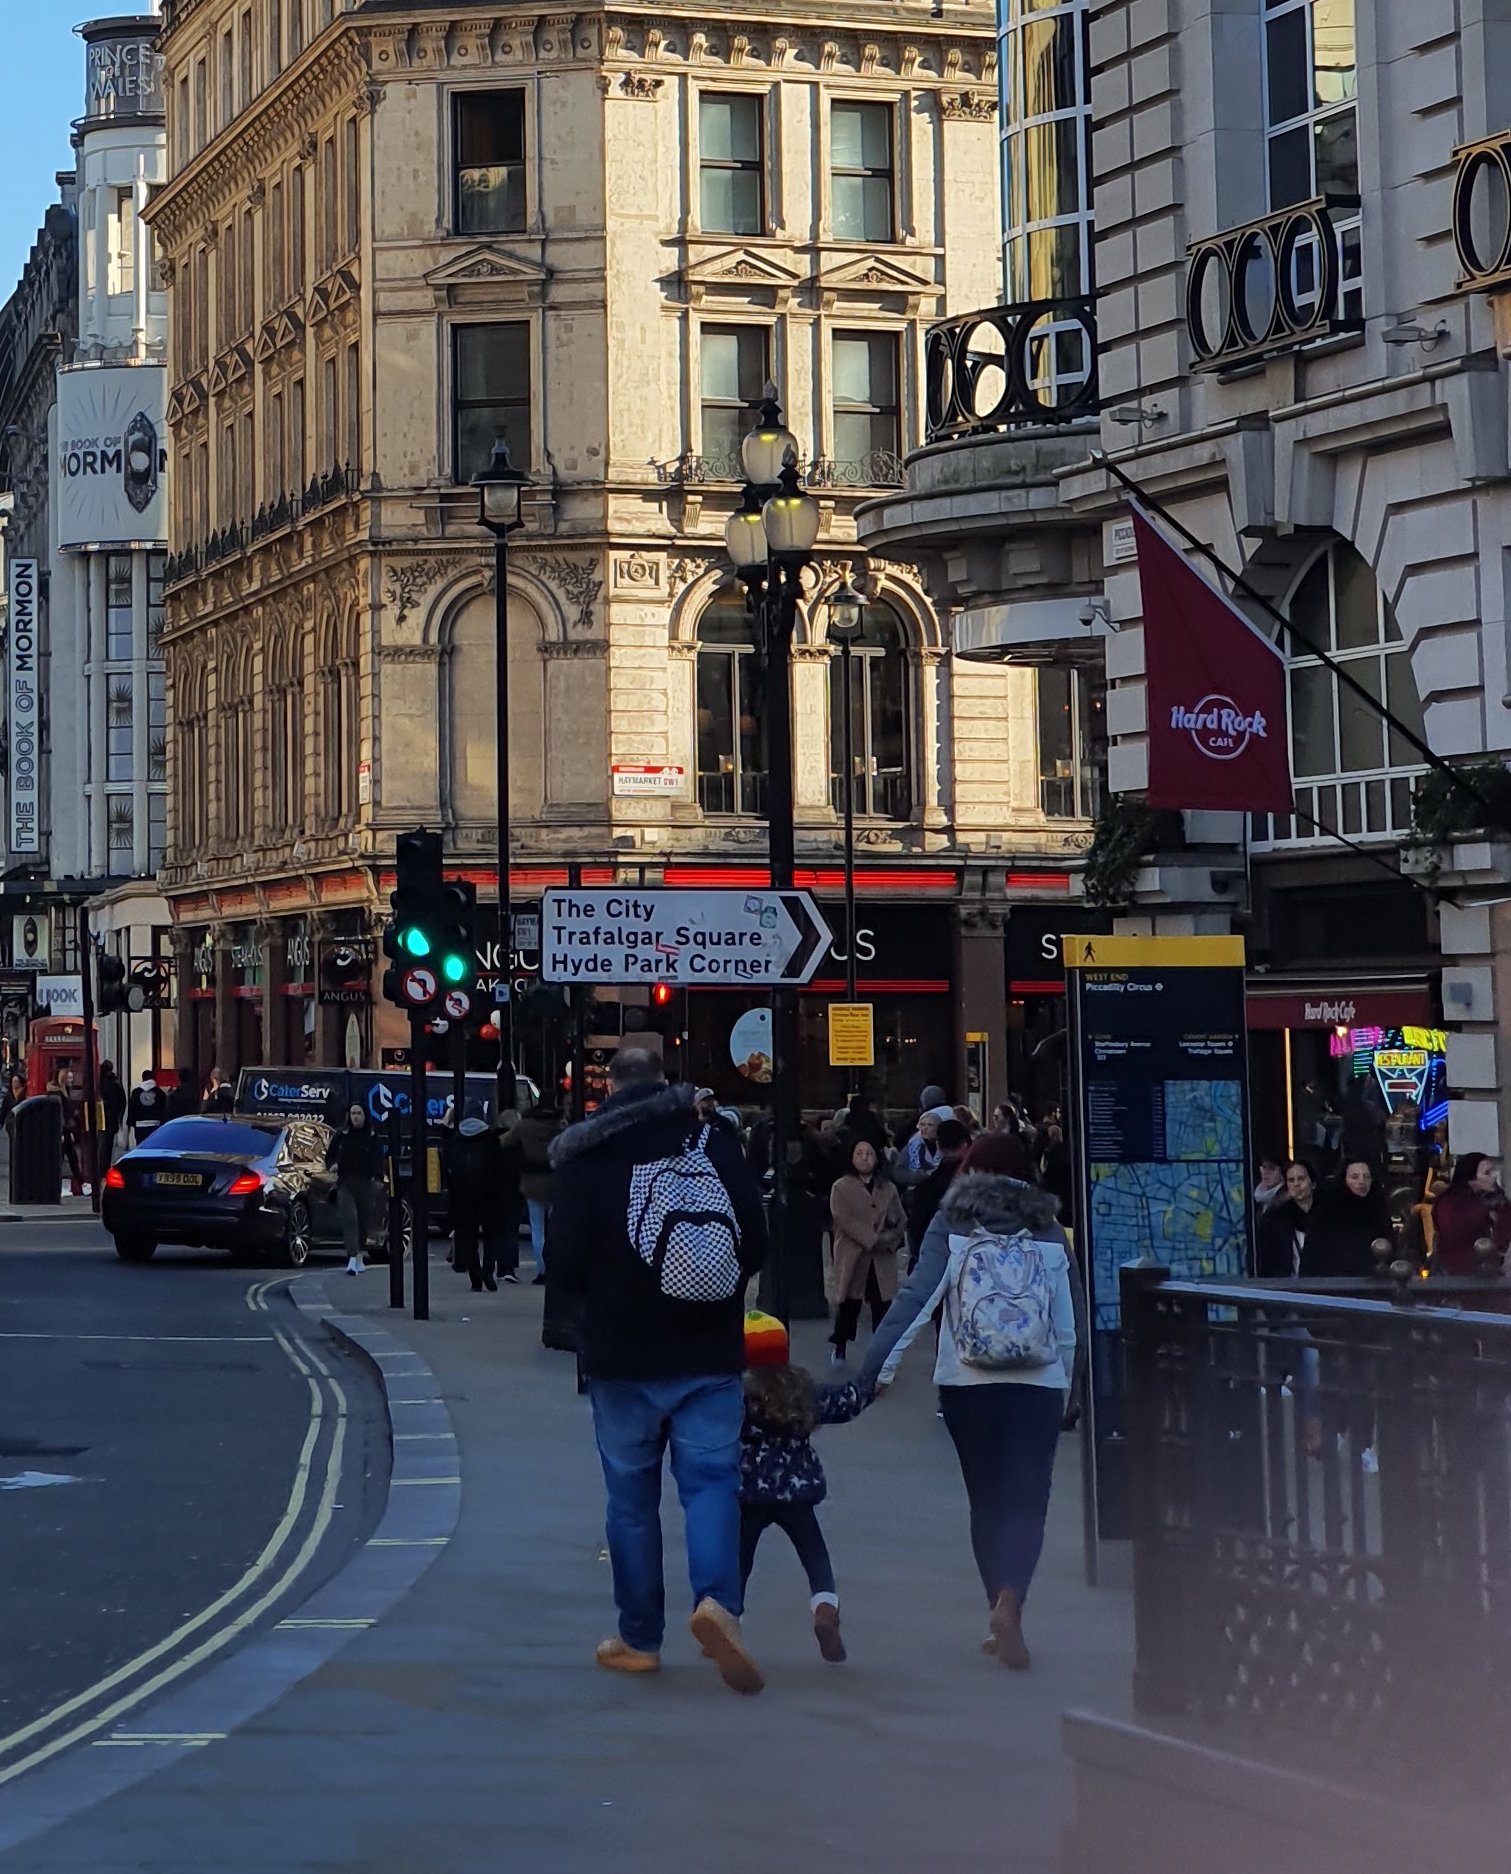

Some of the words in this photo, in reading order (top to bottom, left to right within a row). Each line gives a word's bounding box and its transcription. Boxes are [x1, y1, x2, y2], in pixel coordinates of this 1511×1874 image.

[90, 43, 151, 67] PRINCE
[106, 66, 121, 77] OF
[90, 76, 152, 99] WALES
[71, 437, 100, 451] BOOK
[103, 436, 122, 449] OF
[15, 563, 34, 671] MORMON
[15, 679, 34, 713] OF
[1170, 705, 1219, 730] Hard
[1220, 708, 1268, 738] Rock
[15, 721, 35, 791] BOOK
[618, 776, 662, 786] HAYMARKET
[16, 801, 35, 848] THE
[552, 898, 596, 919] The
[605, 898, 655, 923] City
[552, 926, 664, 949] Trafalgar
[675, 926, 762, 950] Square
[551, 953, 613, 977] Hyde
[624, 953, 678, 974] Park
[689, 953, 773, 974] Corner
[323, 990, 365, 1003] ANGUS
